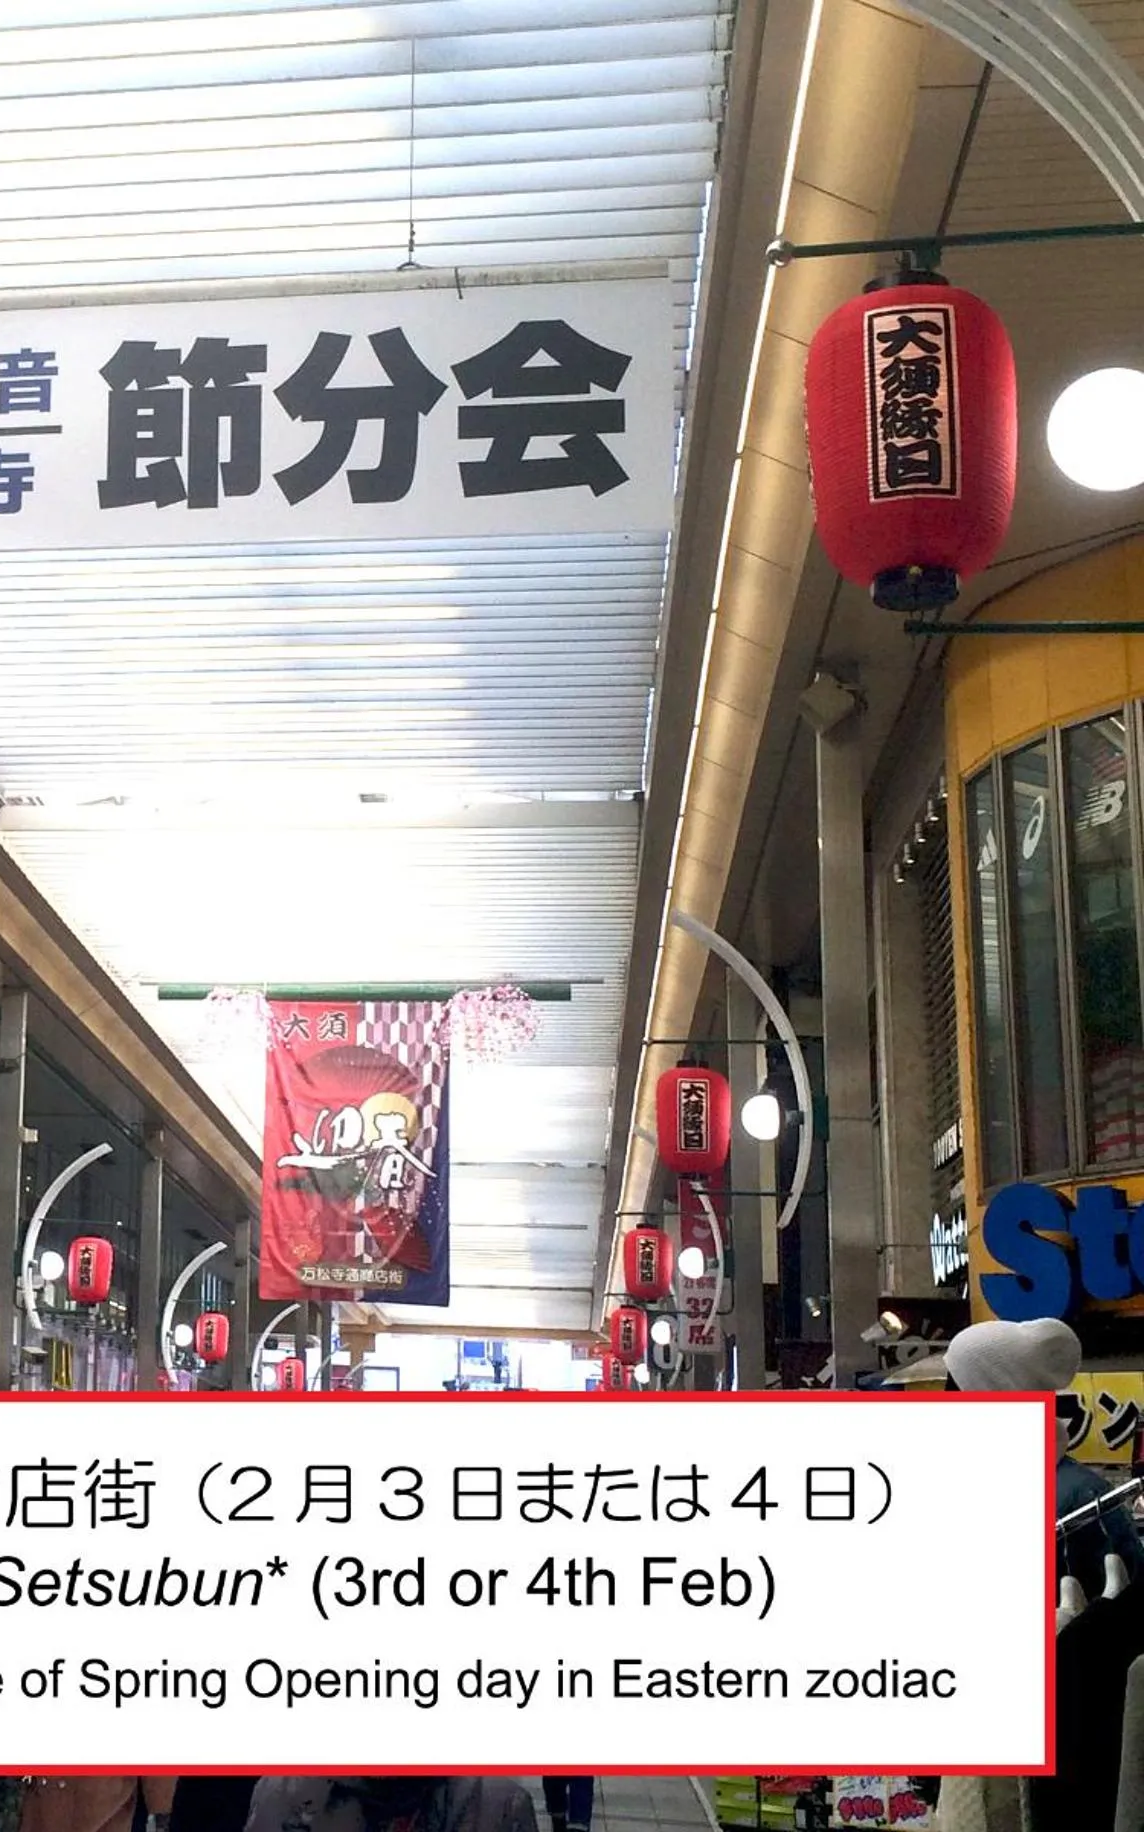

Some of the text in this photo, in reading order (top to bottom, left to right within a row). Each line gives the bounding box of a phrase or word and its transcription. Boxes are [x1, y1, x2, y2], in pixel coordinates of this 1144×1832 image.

[97, 319, 633, 509] 節分会
[282, 1011, 349, 1041] 大須
[980, 1182, 1144, 1324] St
